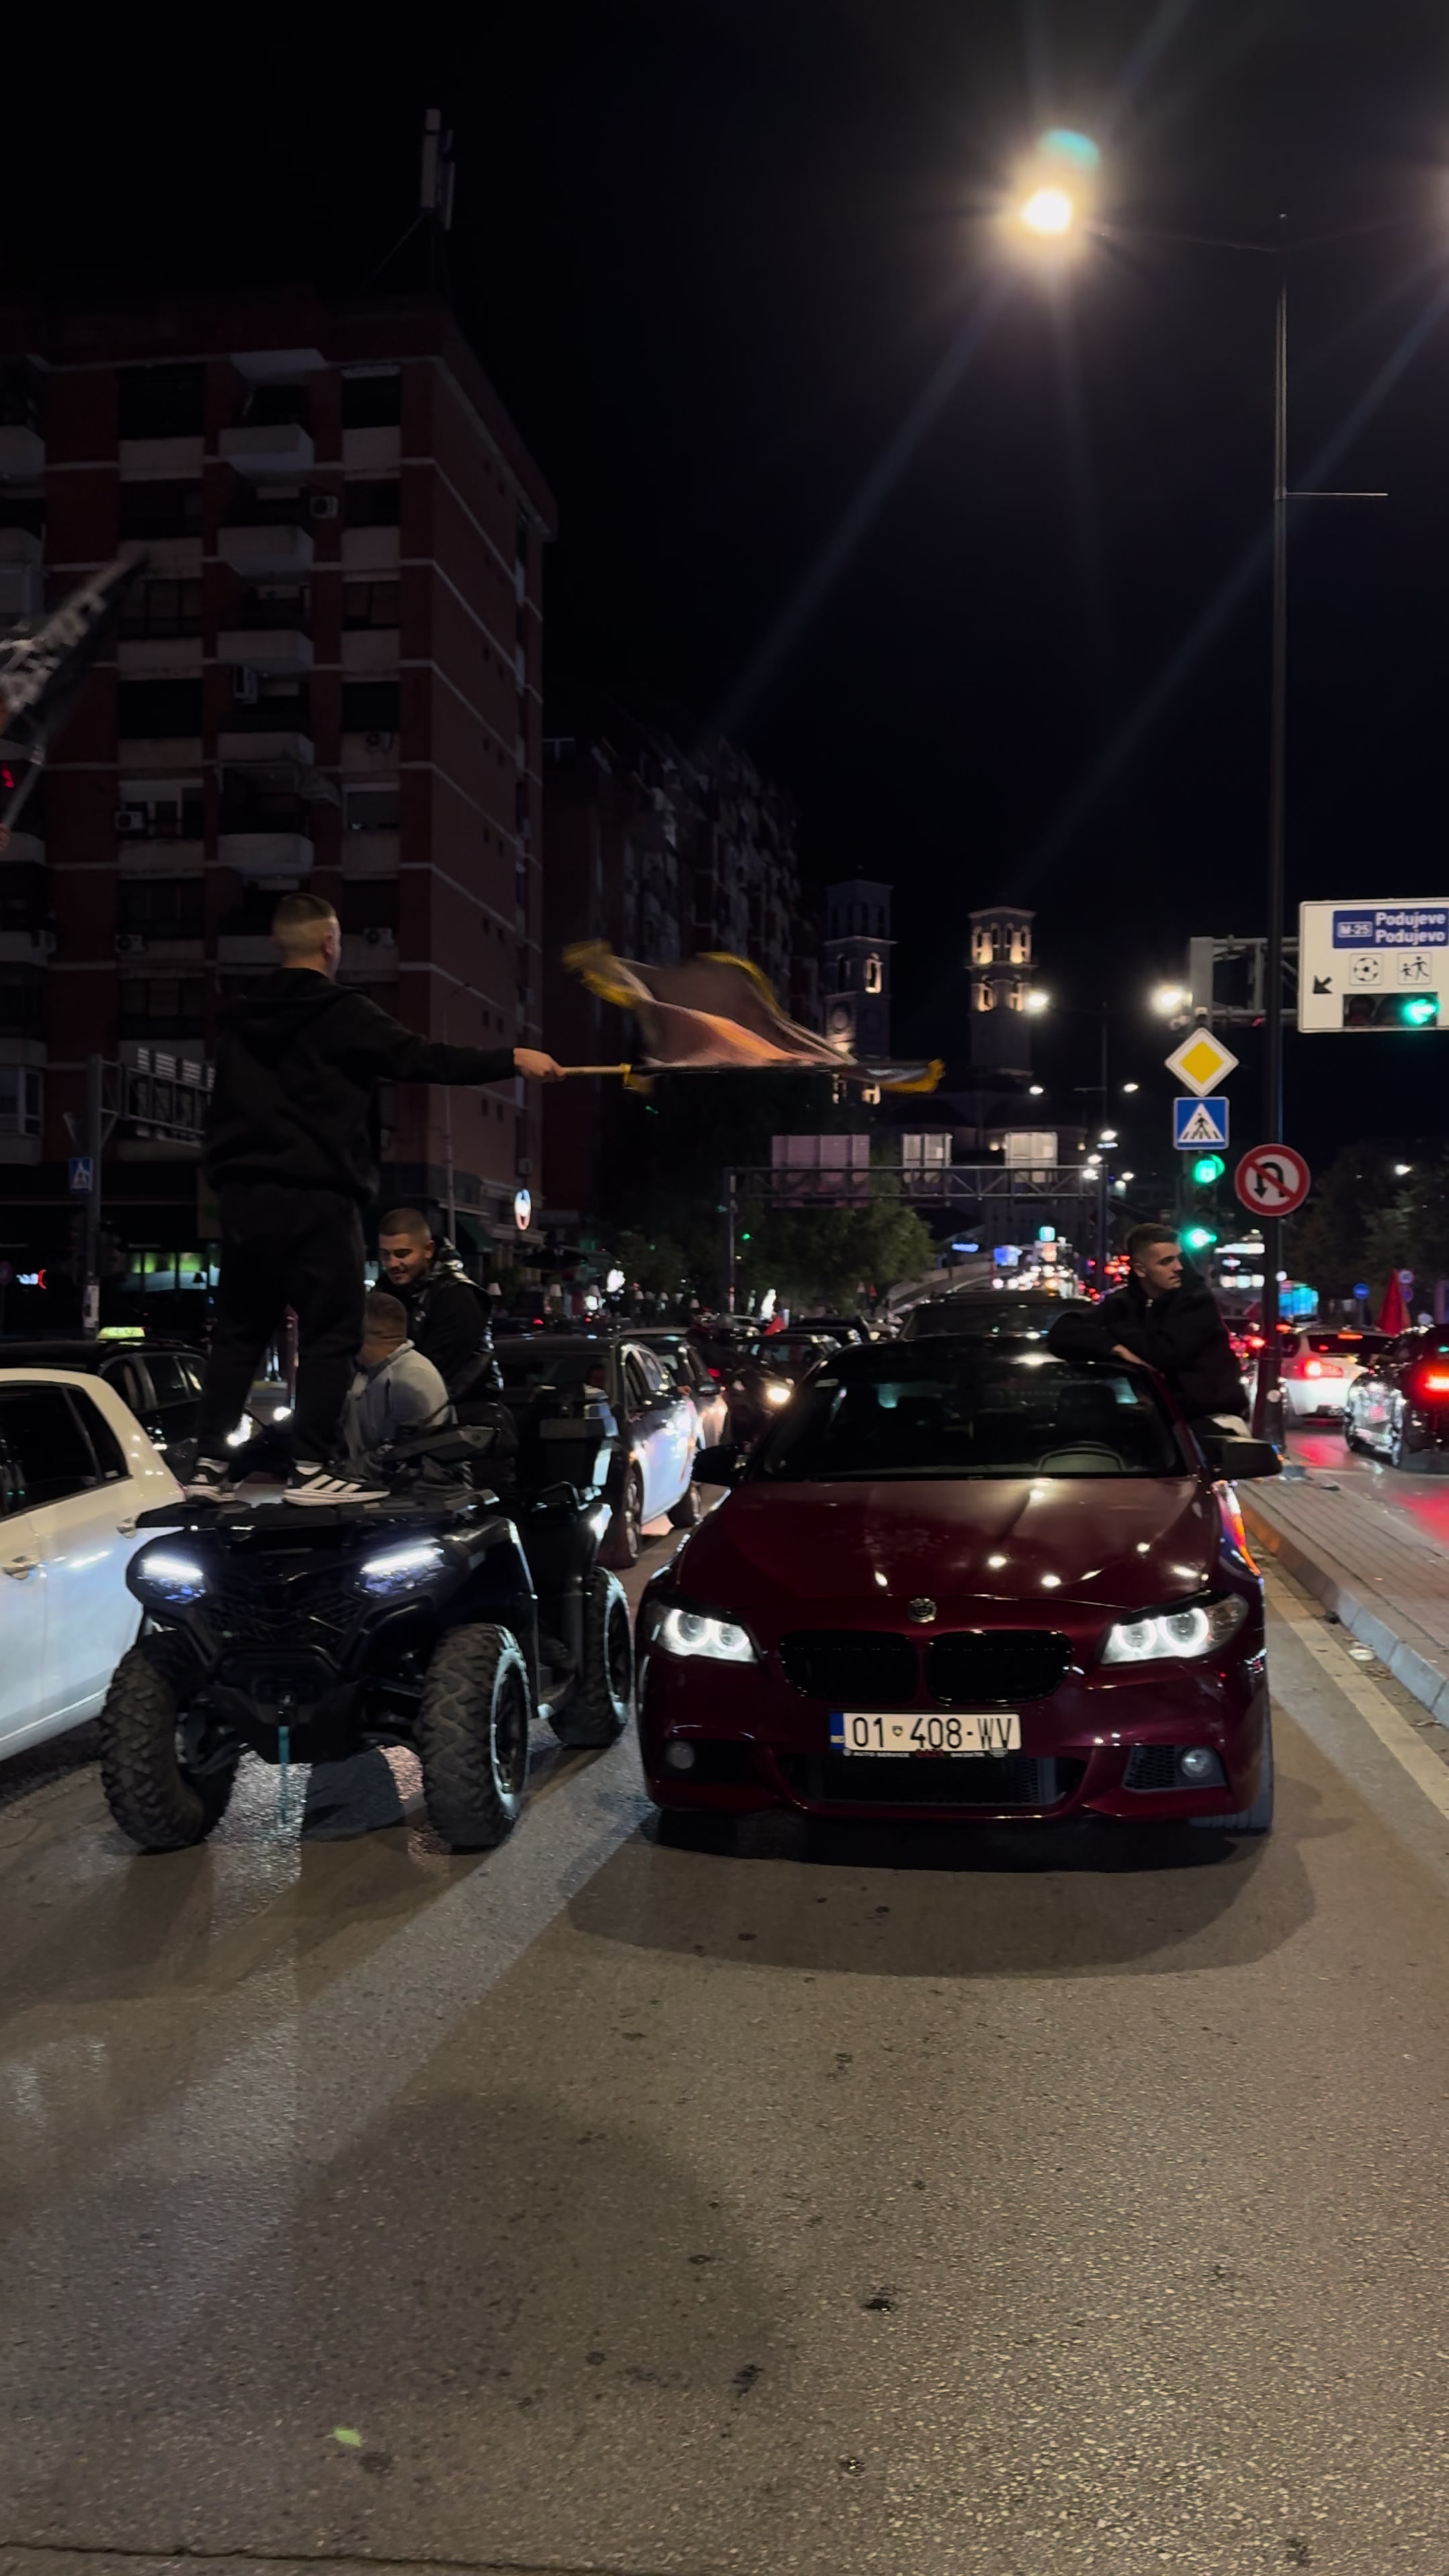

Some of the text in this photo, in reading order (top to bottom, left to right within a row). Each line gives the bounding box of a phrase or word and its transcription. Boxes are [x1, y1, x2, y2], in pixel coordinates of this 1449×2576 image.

[1376, 912, 1446, 928] Podujeve
[1341, 924, 1370, 935] M-25
[1376, 929, 1446, 946] Podujevo
[853, 1717, 883, 1748] 01
